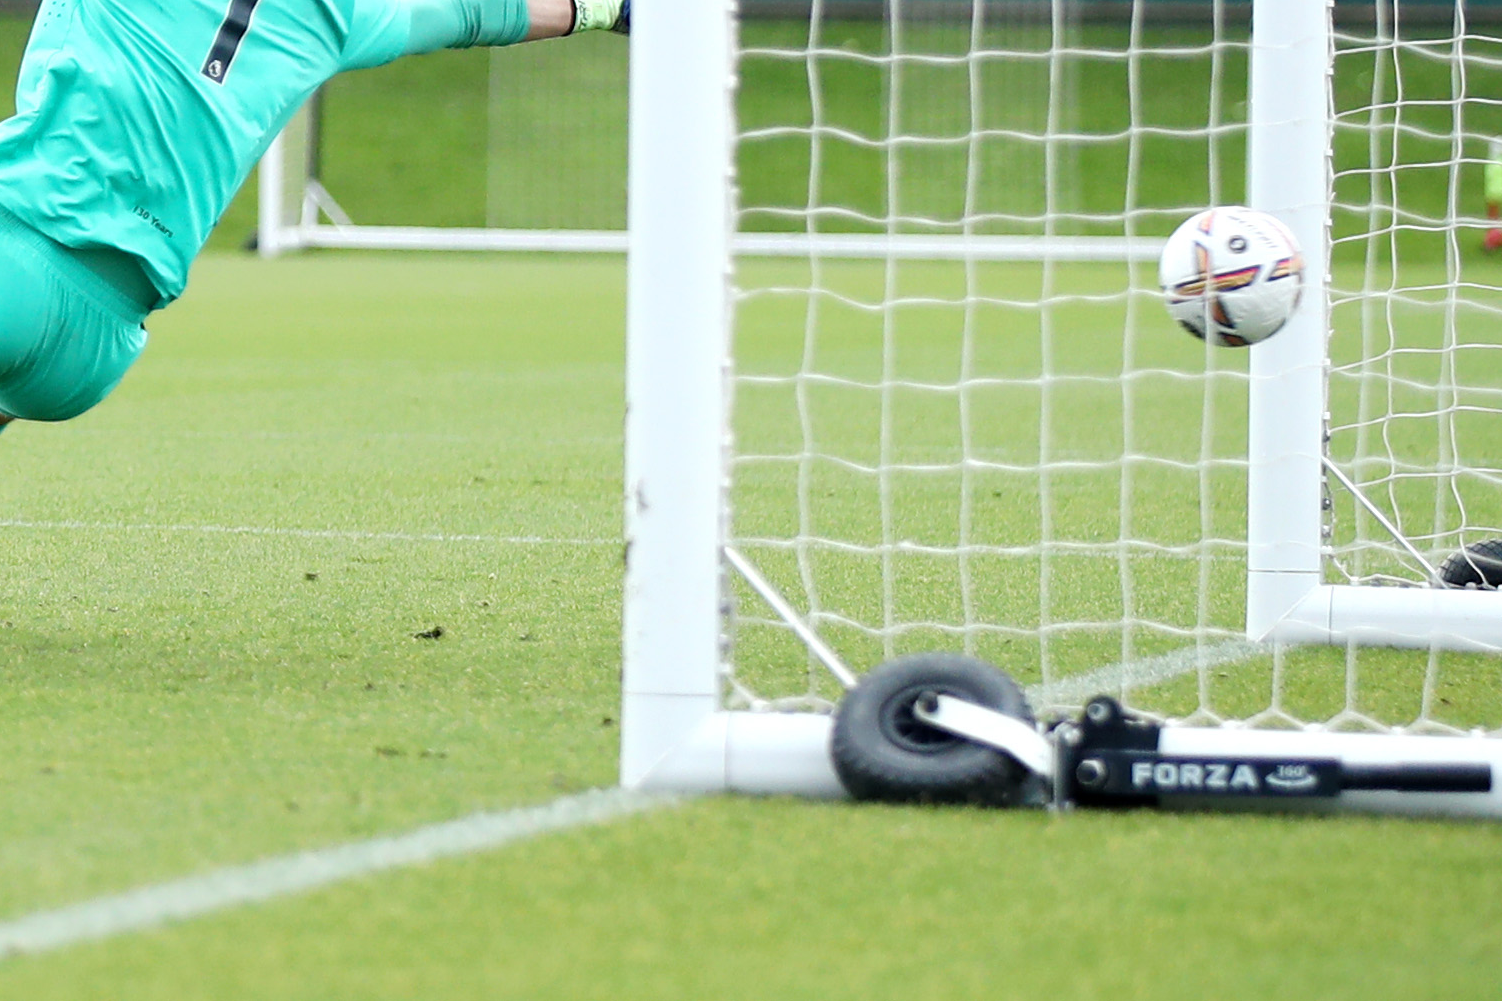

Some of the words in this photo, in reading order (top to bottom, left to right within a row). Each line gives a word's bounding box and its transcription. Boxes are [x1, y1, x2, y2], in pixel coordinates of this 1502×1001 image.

[132, 205, 150, 220] 130
[151, 215, 174, 239] Years
[1132, 762, 1259, 789] FORZA
